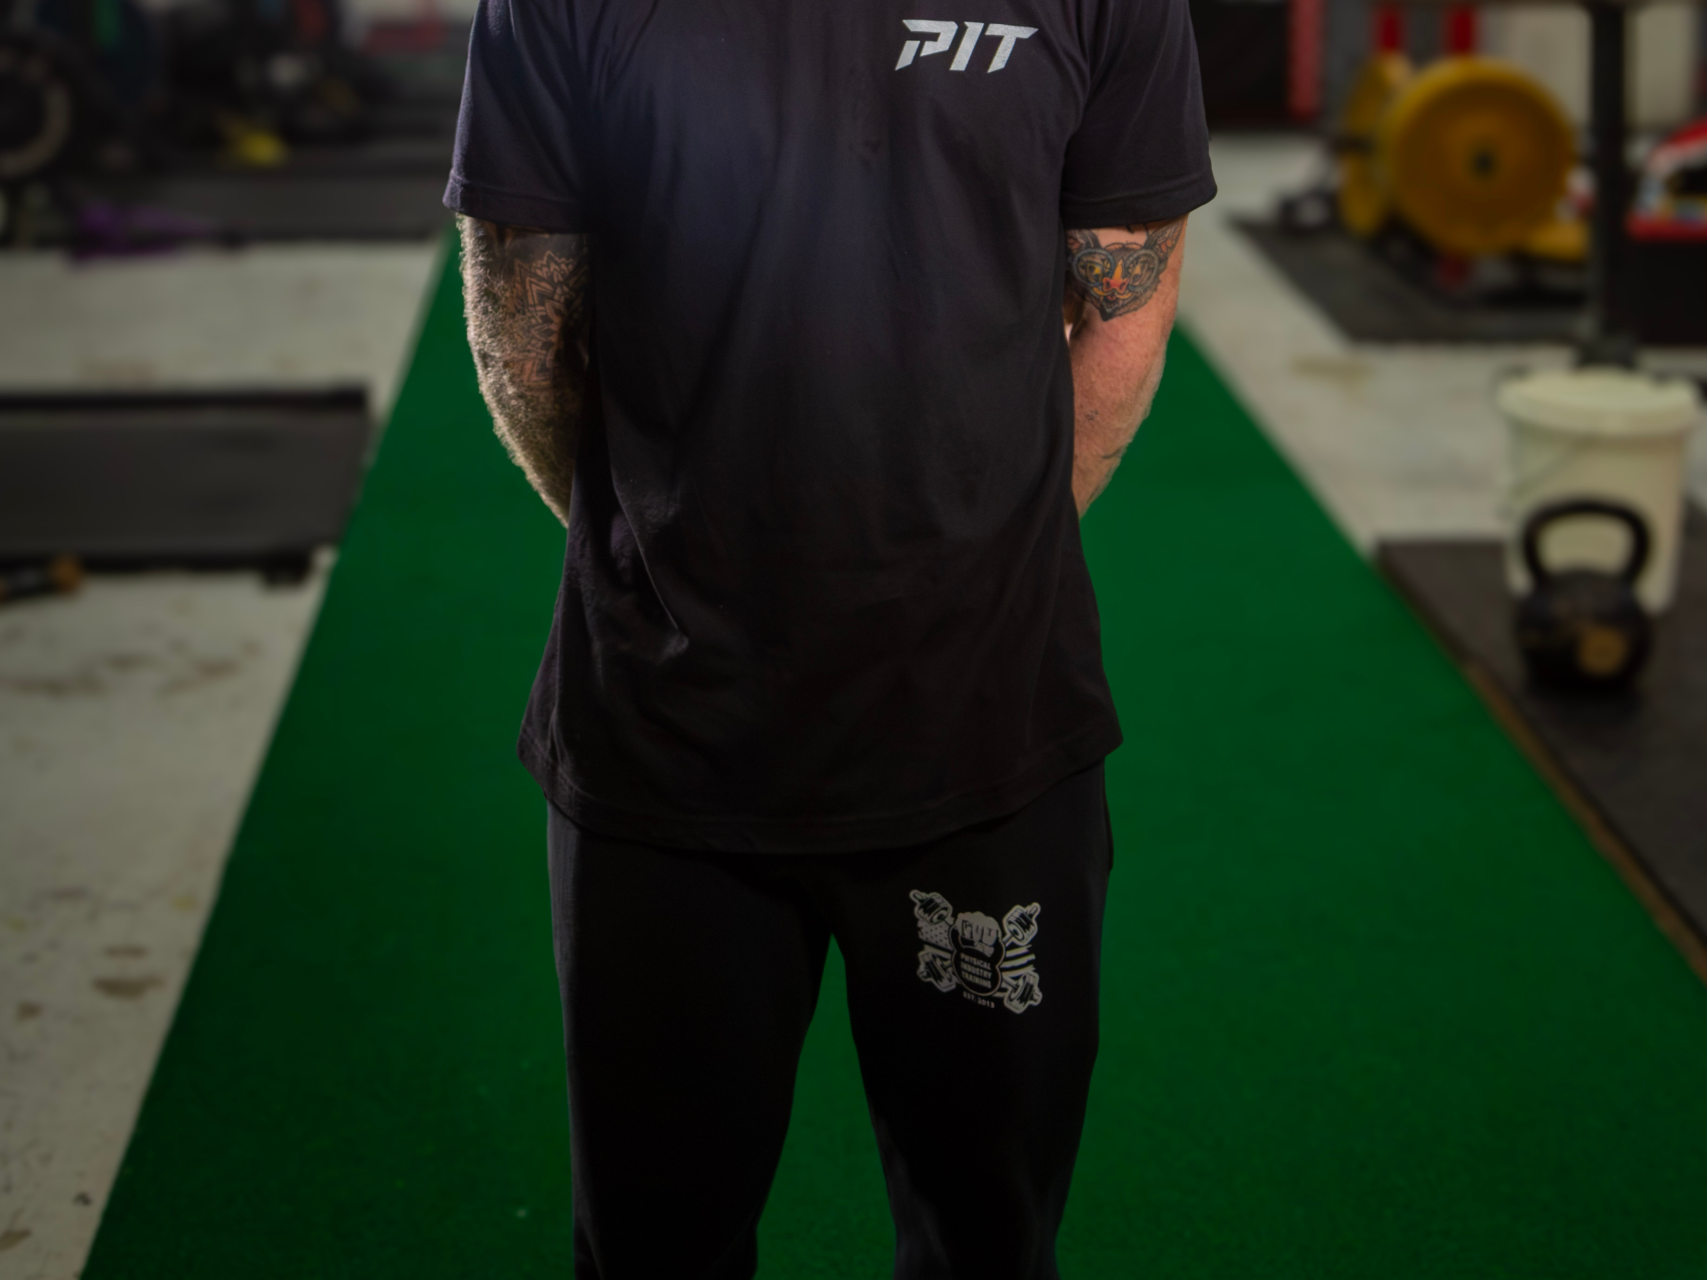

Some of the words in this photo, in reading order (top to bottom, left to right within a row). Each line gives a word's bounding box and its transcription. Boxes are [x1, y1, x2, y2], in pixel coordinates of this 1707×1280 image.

[895, 19, 1039, 73] PIT
[960, 952, 991, 971] PHYSICAL
[960, 961, 993, 979] INDUSTRY
[961, 970, 992, 989] TRAINING
